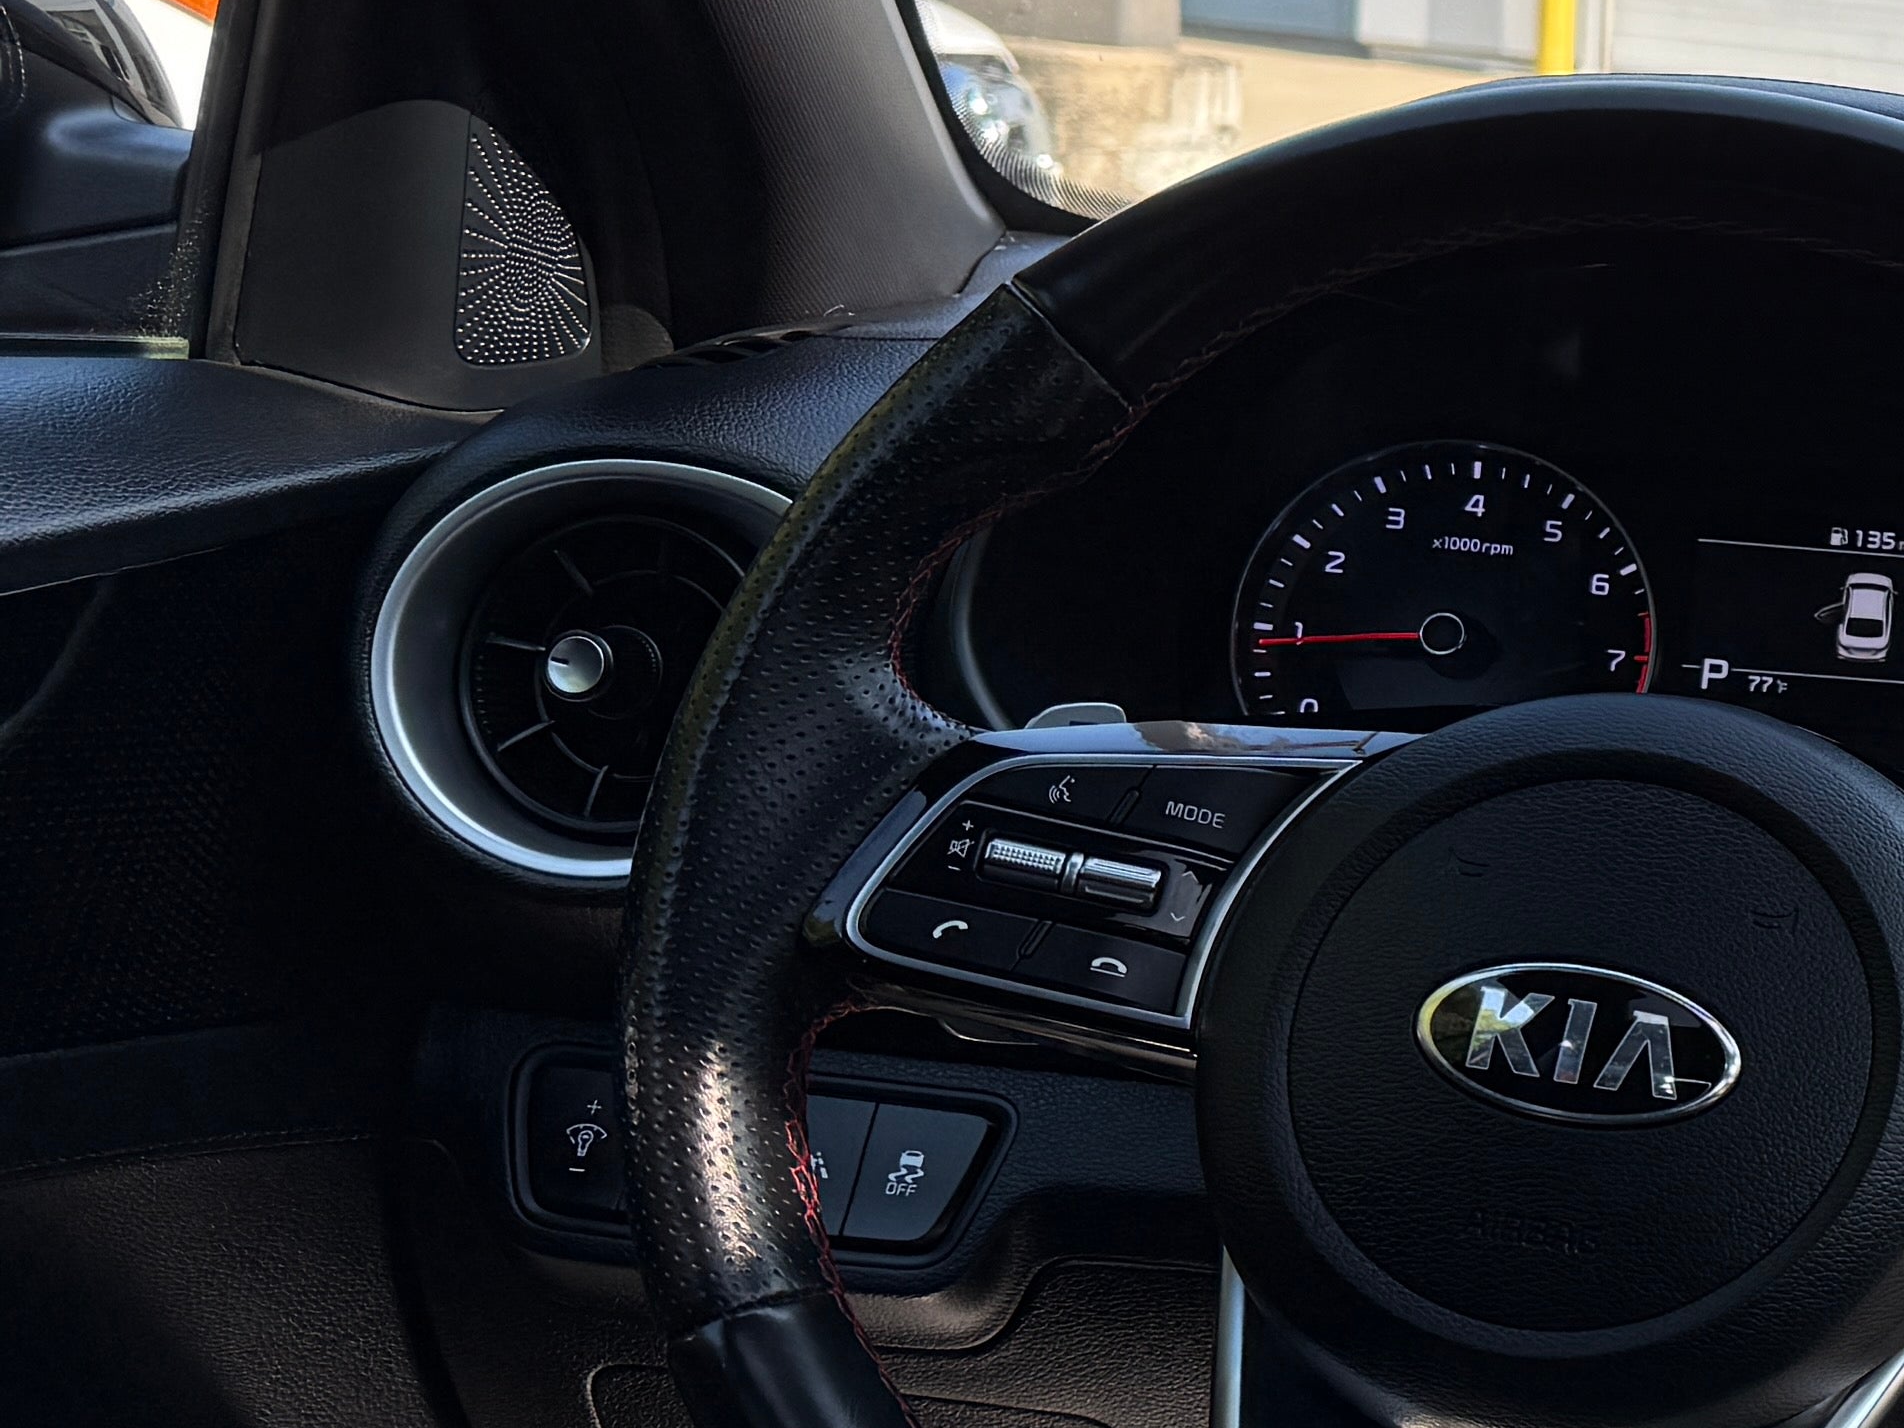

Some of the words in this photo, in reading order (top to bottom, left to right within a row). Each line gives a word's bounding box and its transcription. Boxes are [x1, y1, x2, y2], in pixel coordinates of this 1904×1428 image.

[1465, 494, 1485, 517] 4
[1385, 508, 1406, 530] 3
[1543, 520, 1563, 542] 5
[1324, 551, 1345, 573] 2
[1591, 573, 1610, 596] 6
[1607, 649, 1626, 672] 7
[1701, 658, 1729, 690] P
[1165, 801, 1225, 829] MODE
[1465, 986, 1677, 1100] KIA
[885, 1183, 918, 1197] OFF
